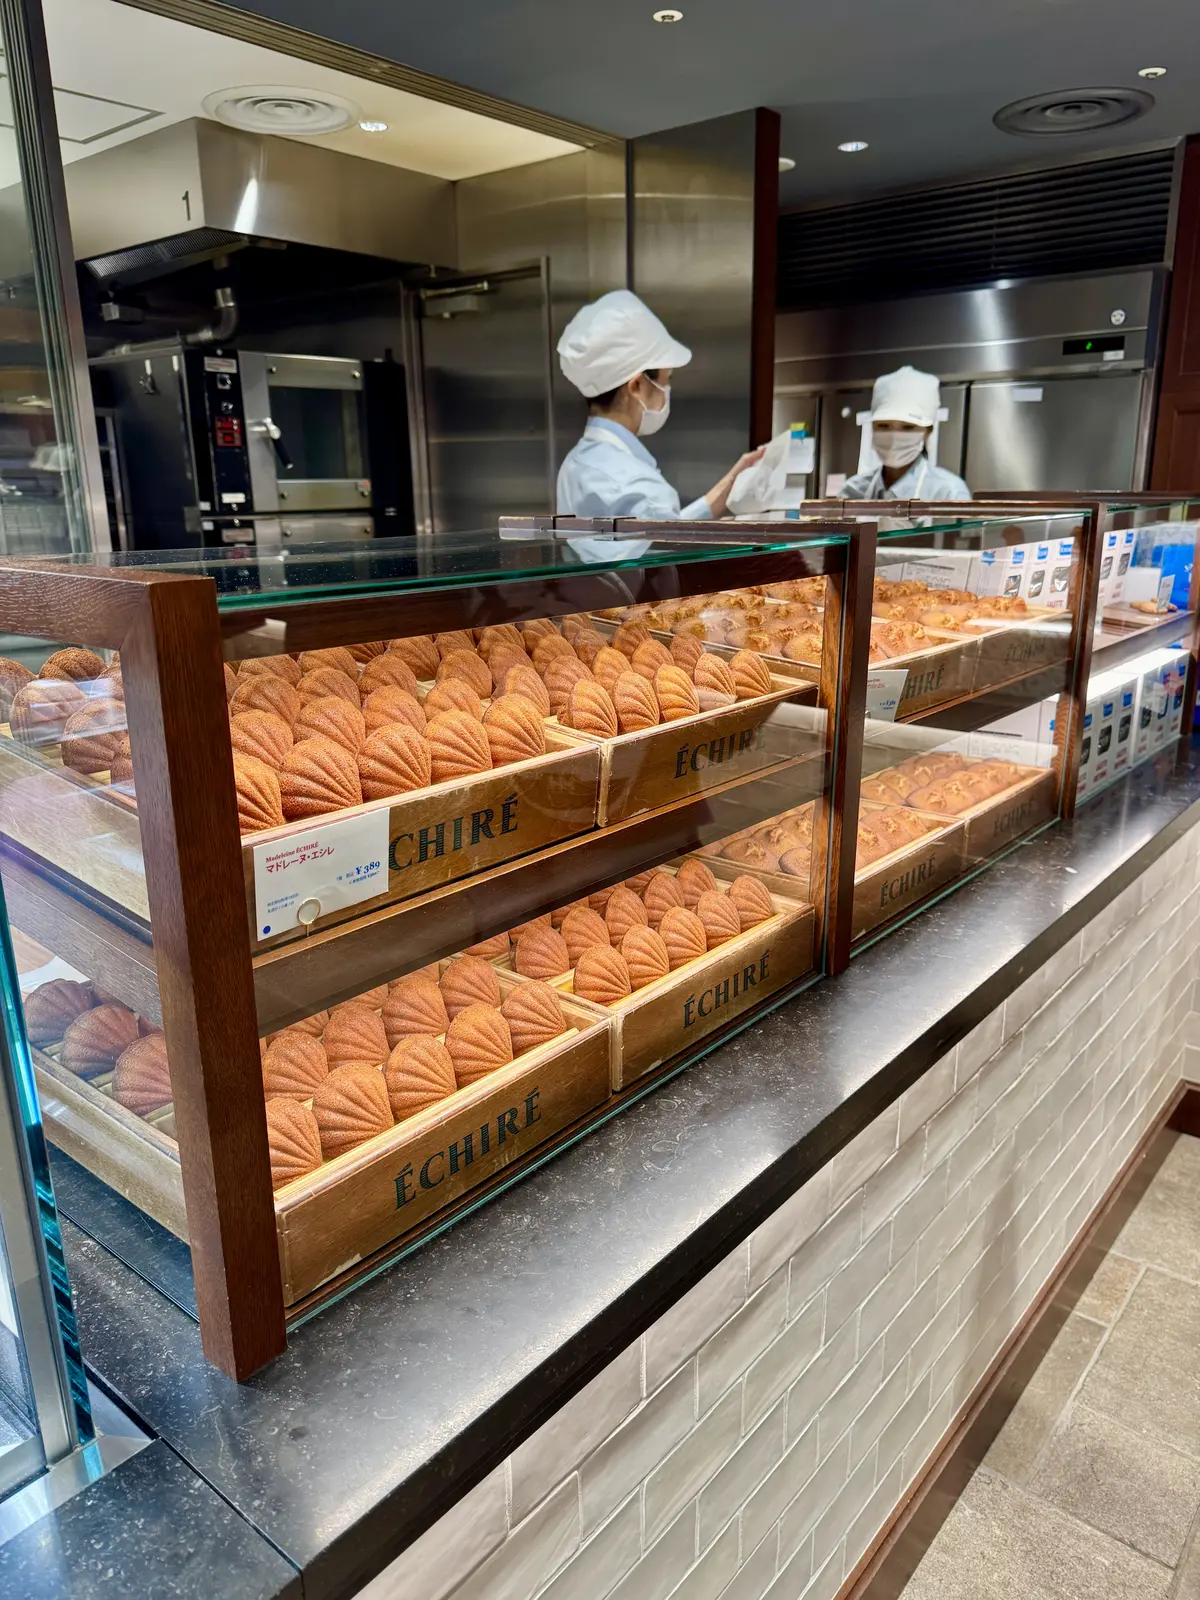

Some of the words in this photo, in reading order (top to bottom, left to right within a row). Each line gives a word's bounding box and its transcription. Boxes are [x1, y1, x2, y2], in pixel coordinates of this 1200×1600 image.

[182, 190, 191, 221] 1
[673, 721, 766, 780] ÉCHIRÉ
[265, 850, 296, 864] Madeleine
[295, 841, 319, 854] ÉCHIRÉ
[265, 846, 335, 874] マドレーヌ・エシレ
[355, 860, 381, 876] ¥389
[879, 852, 937, 908] ÉCHIRÉ
[683, 949, 771, 1030] ÉCHIRÉ
[393, 1086, 542, 1211] ÉCHIRÉ
